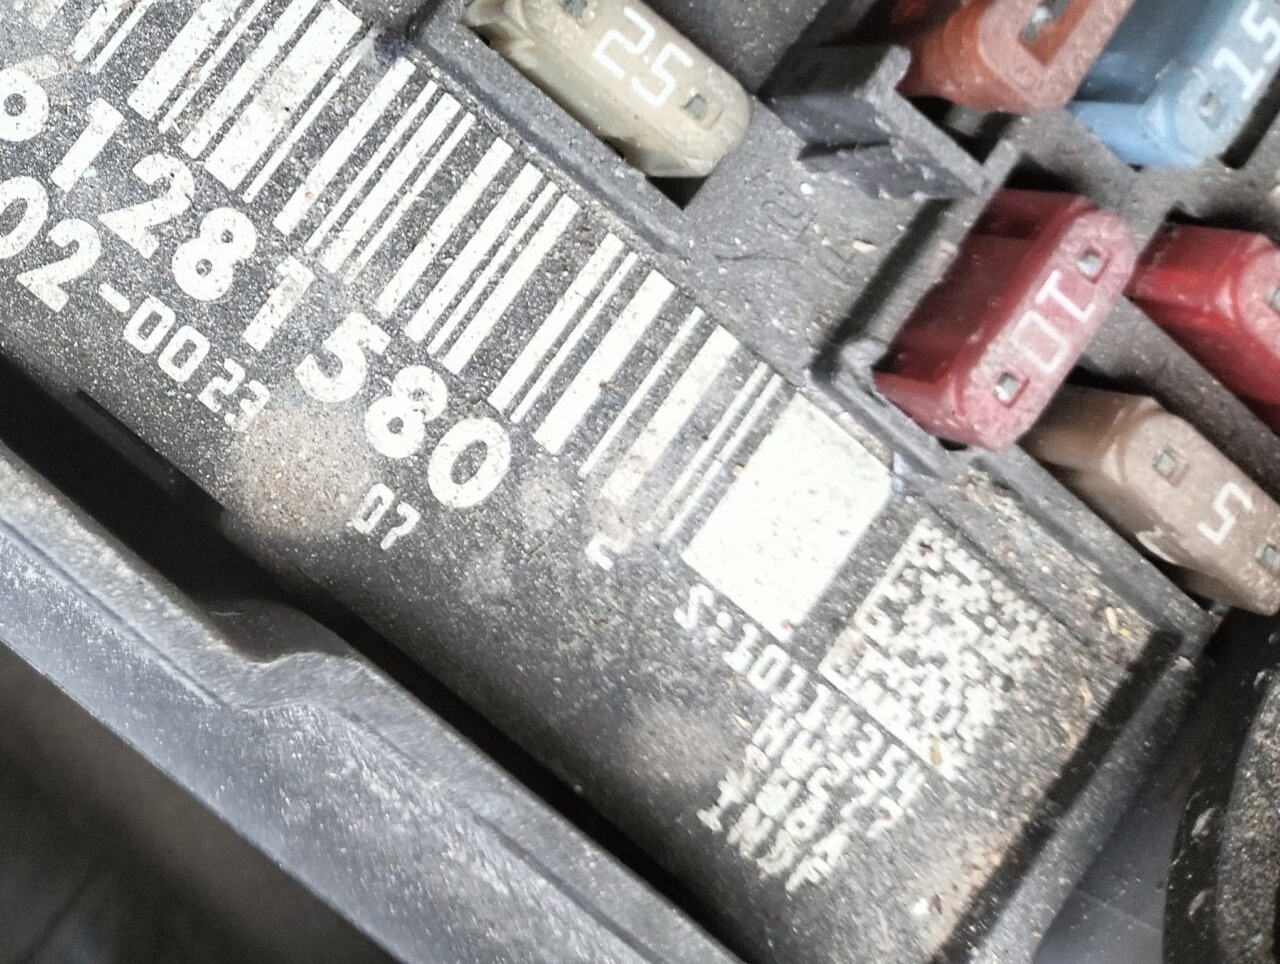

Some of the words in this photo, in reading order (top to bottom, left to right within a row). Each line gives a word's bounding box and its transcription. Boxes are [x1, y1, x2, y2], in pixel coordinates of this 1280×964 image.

[593, 6, 694, 108] 25
[1020, 270, 1098, 373] 10
[1197, 481, 1254, 545] 5
